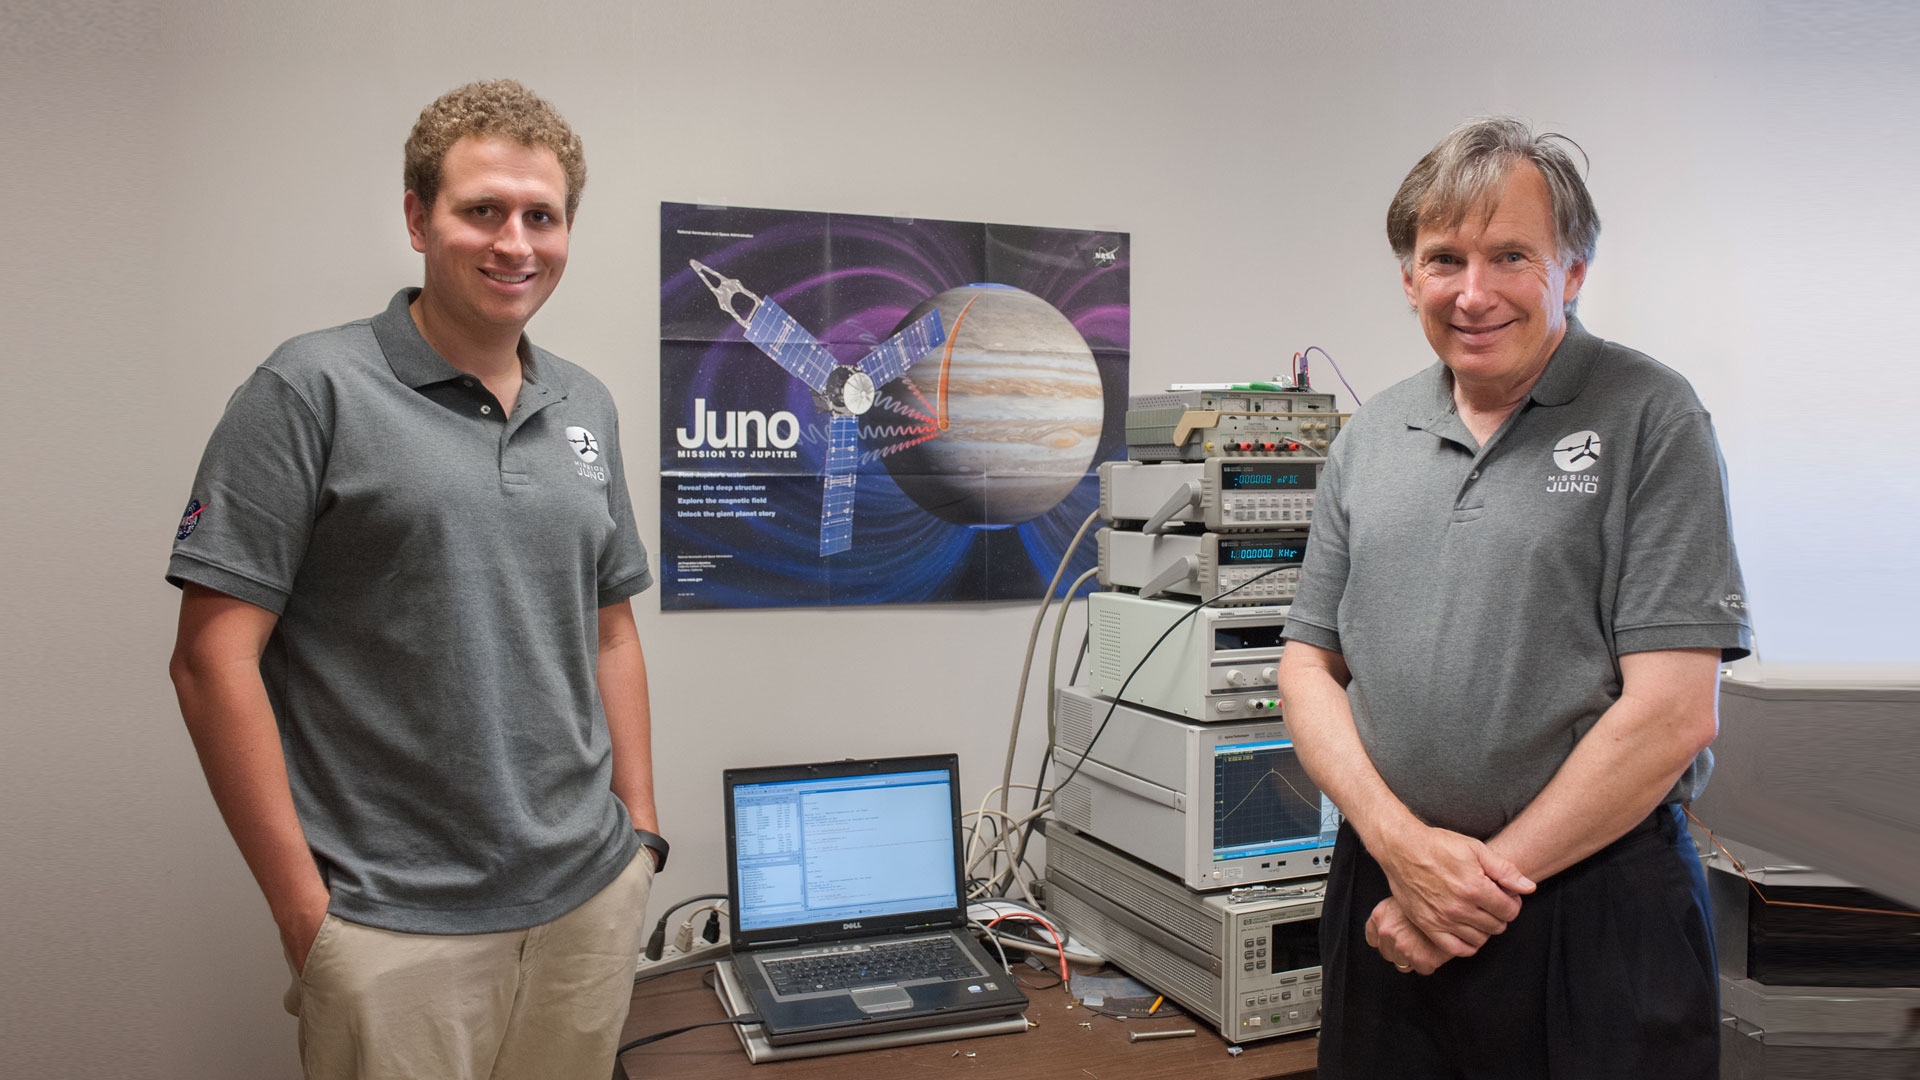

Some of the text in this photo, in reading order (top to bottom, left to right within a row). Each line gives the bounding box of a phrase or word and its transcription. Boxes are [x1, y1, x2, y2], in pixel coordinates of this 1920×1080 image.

[676, 398, 800, 449] Juno
[677, 450, 798, 458] MISSION TO JUPITER
[574, 460, 604, 472] MISSION
[577, 467, 605, 481] JUNO
[1547, 474, 1599, 482] MISSION
[716, 484, 733, 492] deep
[1546, 481, 1598, 493] JUNO
[677, 497, 704, 505] Explore
[718, 497, 750, 505] magnetic
[716, 510, 734, 518] giant
[758, 510, 776, 518] story
[843, 922, 862, 930] DELL
